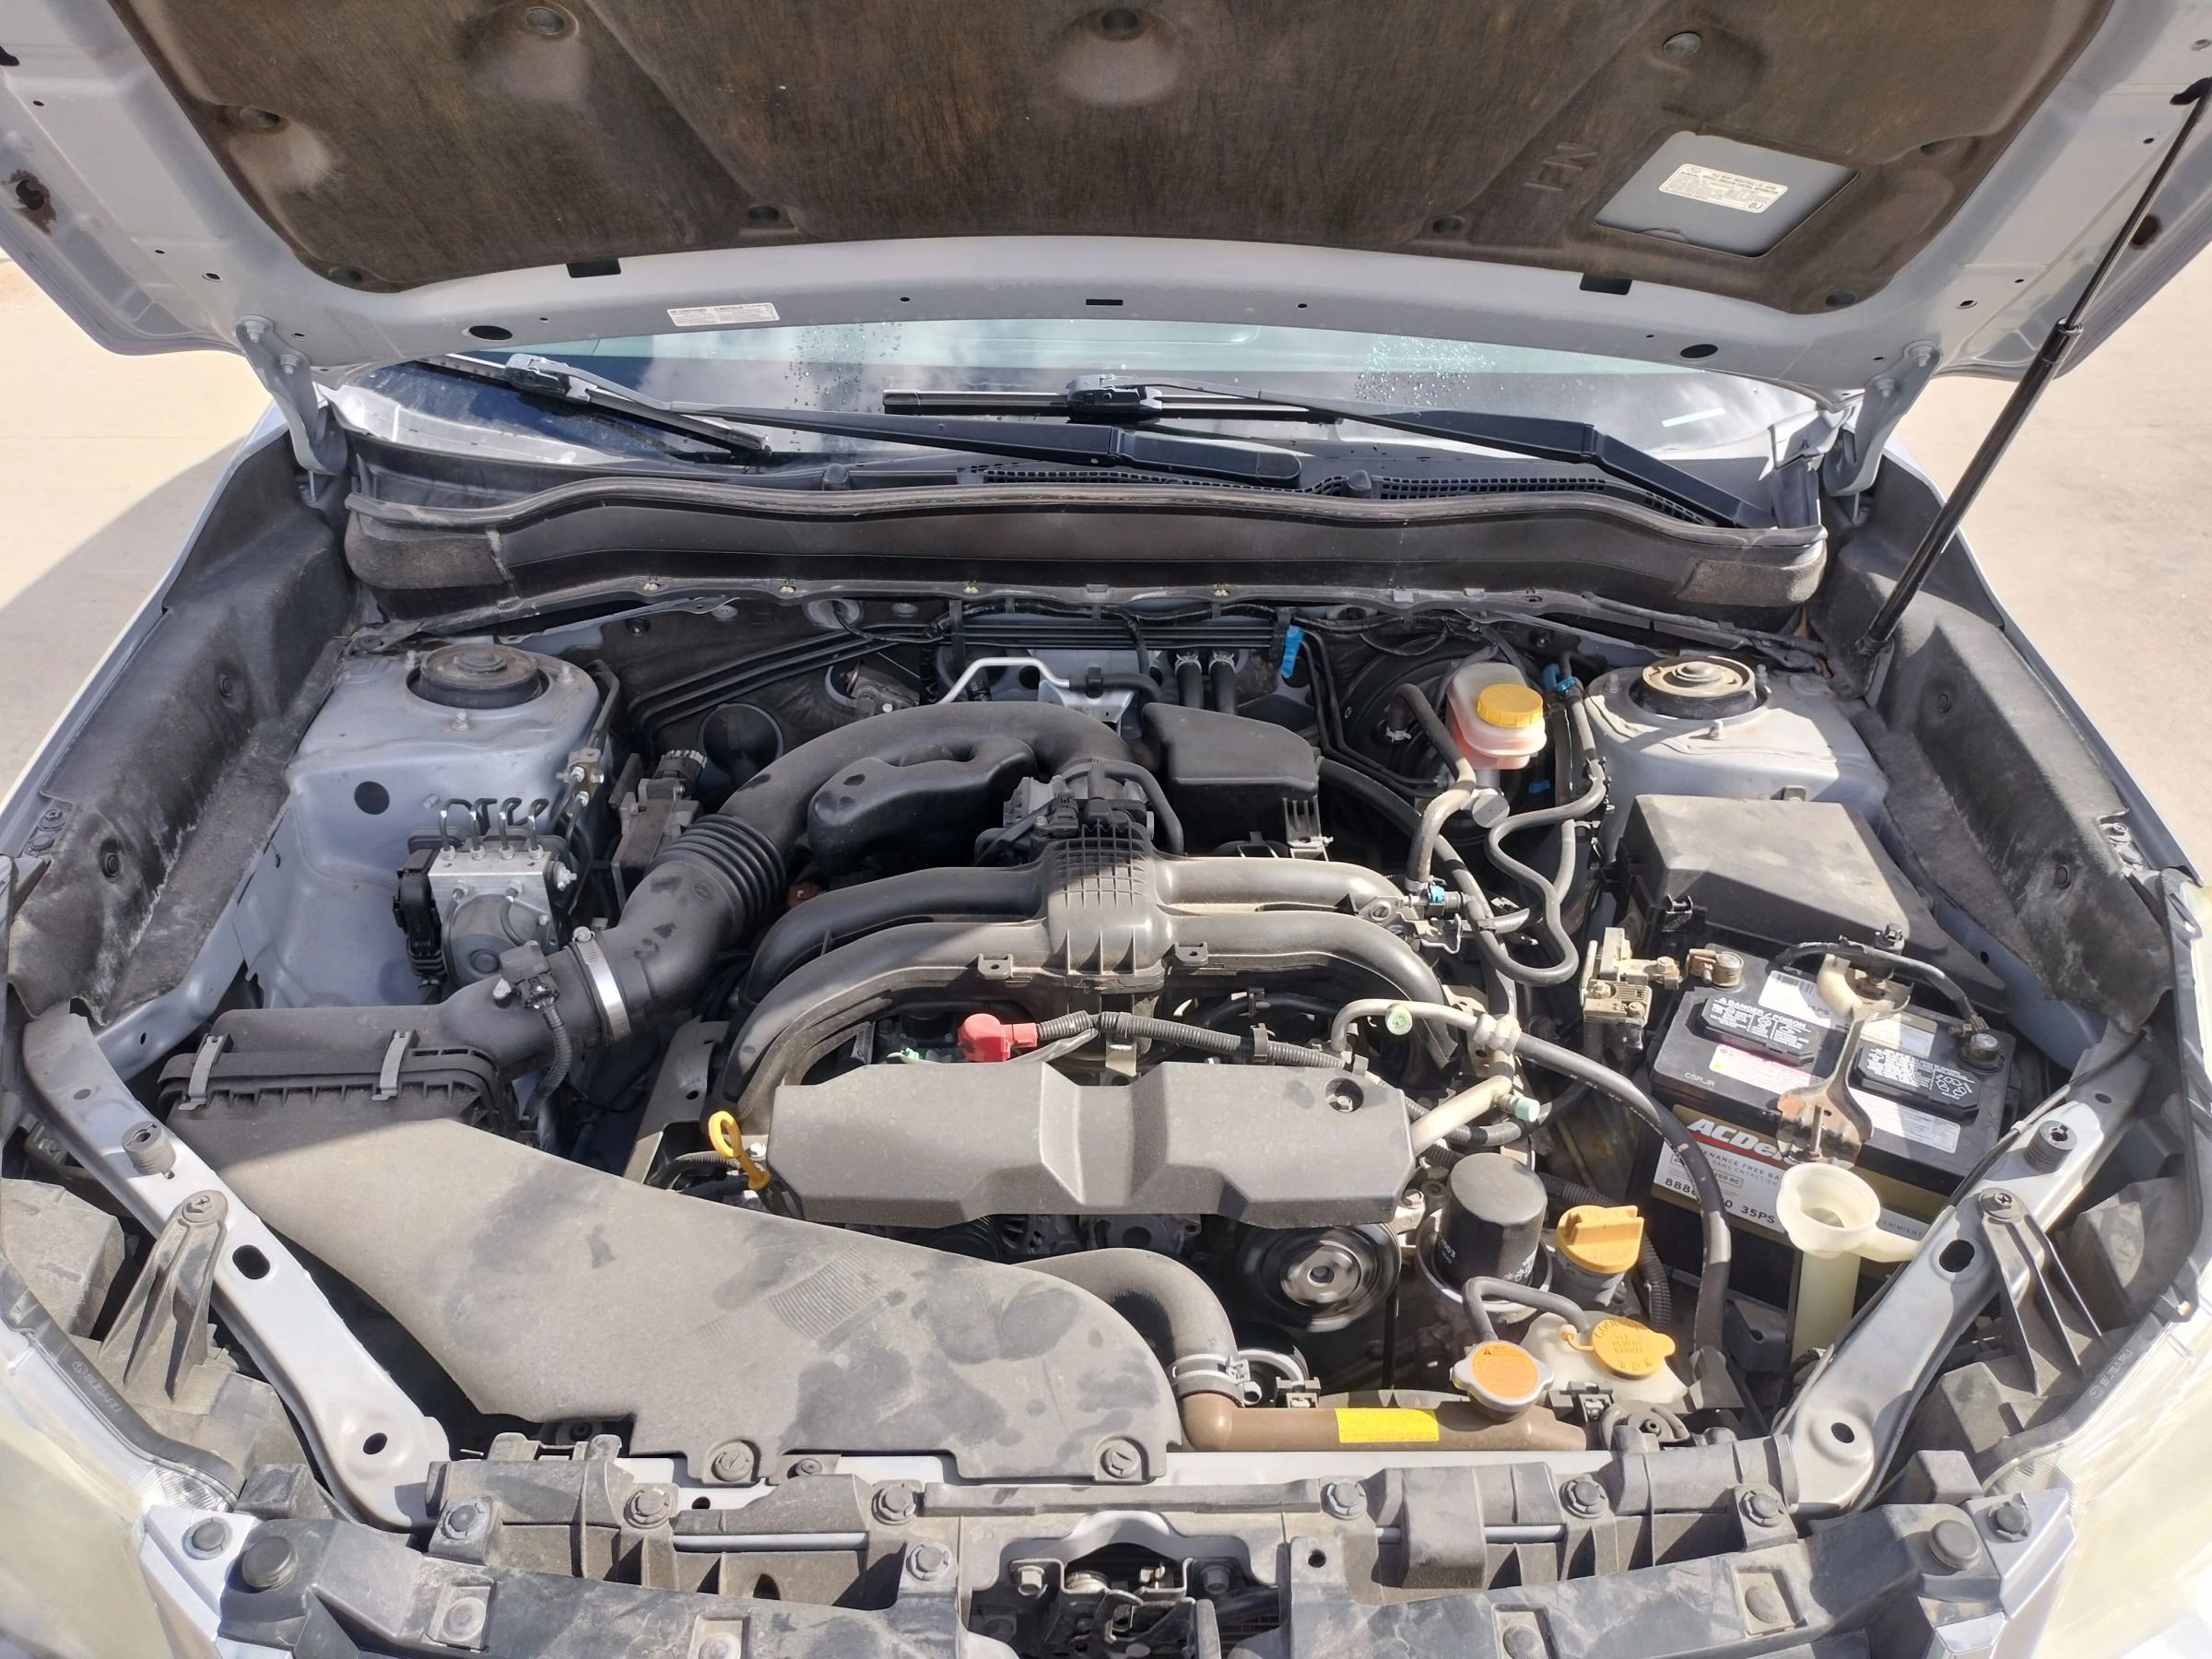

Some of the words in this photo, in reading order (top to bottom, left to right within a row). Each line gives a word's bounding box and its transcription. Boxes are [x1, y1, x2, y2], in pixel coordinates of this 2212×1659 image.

[1727, 999, 1764, 1017] DANGER
[1772, 1014, 1806, 1030] POISON
[1742, 1163, 1765, 1175] FREE
[1741, 1206, 1776, 1224] 35PS
